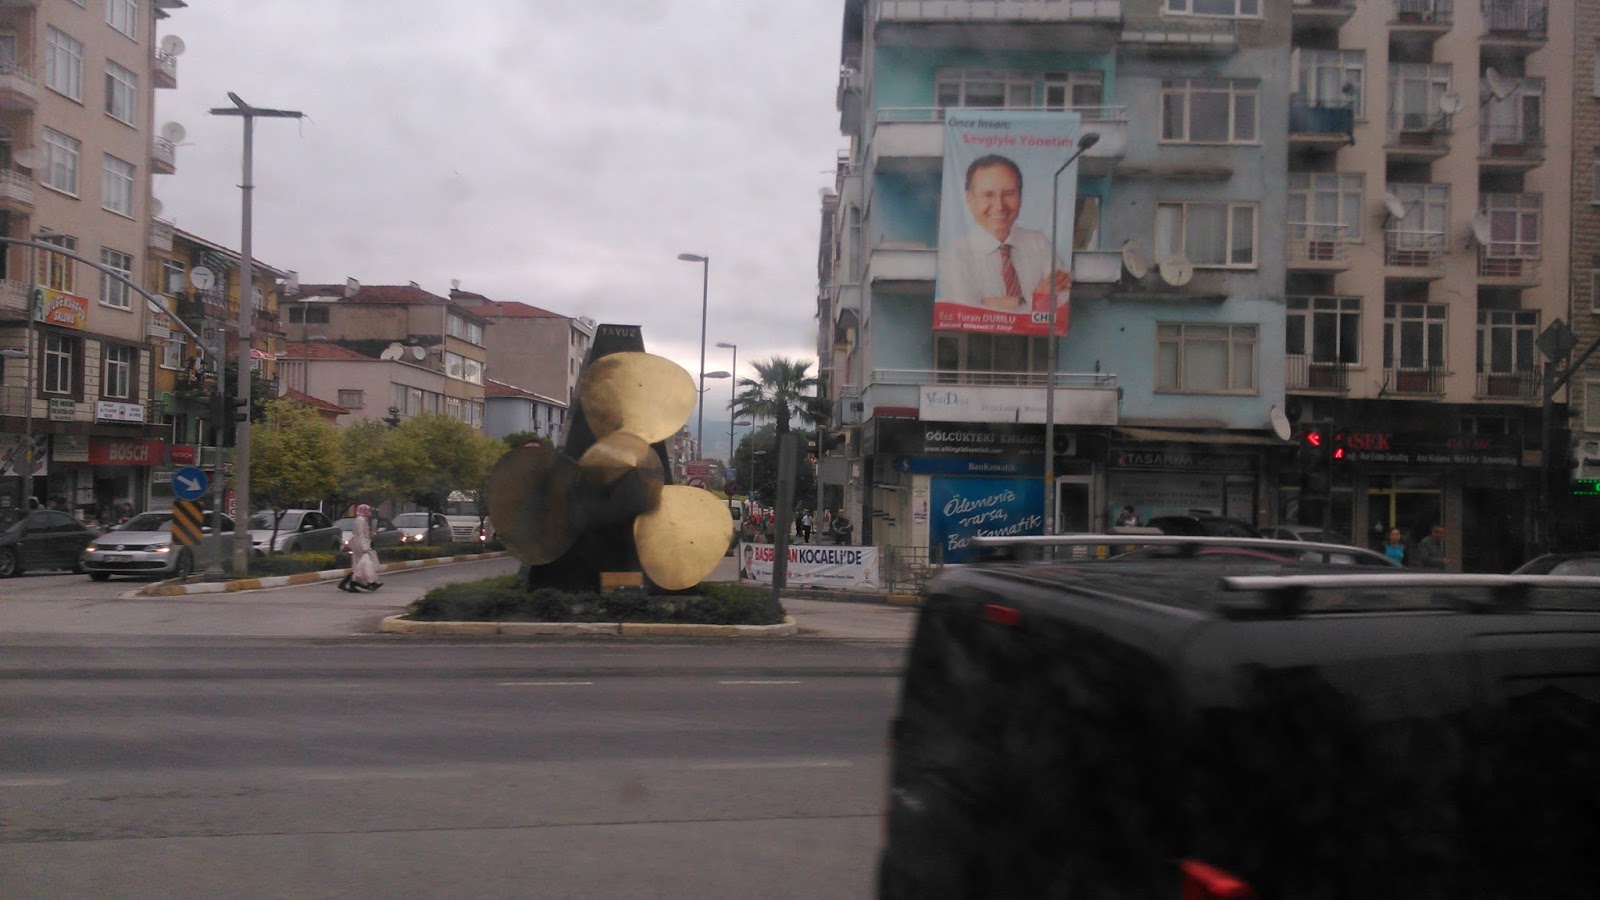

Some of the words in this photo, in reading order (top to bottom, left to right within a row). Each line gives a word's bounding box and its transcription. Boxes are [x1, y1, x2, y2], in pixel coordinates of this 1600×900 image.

[947, 116, 975, 128] Önce
[962, 133, 1016, 147] Sevgiyle
[1019, 134, 1073, 147] Yönetim
[957, 312, 981, 322] Turan
[982, 313, 1016, 323] DUMLU
[602, 326, 636, 337] YAVUZ
[109, 444, 149, 461] BOSCH
[968, 462, 1016, 471] Bankamatik
[943, 489, 1015, 517] Ödemeniz
[959, 508, 1008, 527] varsa,
